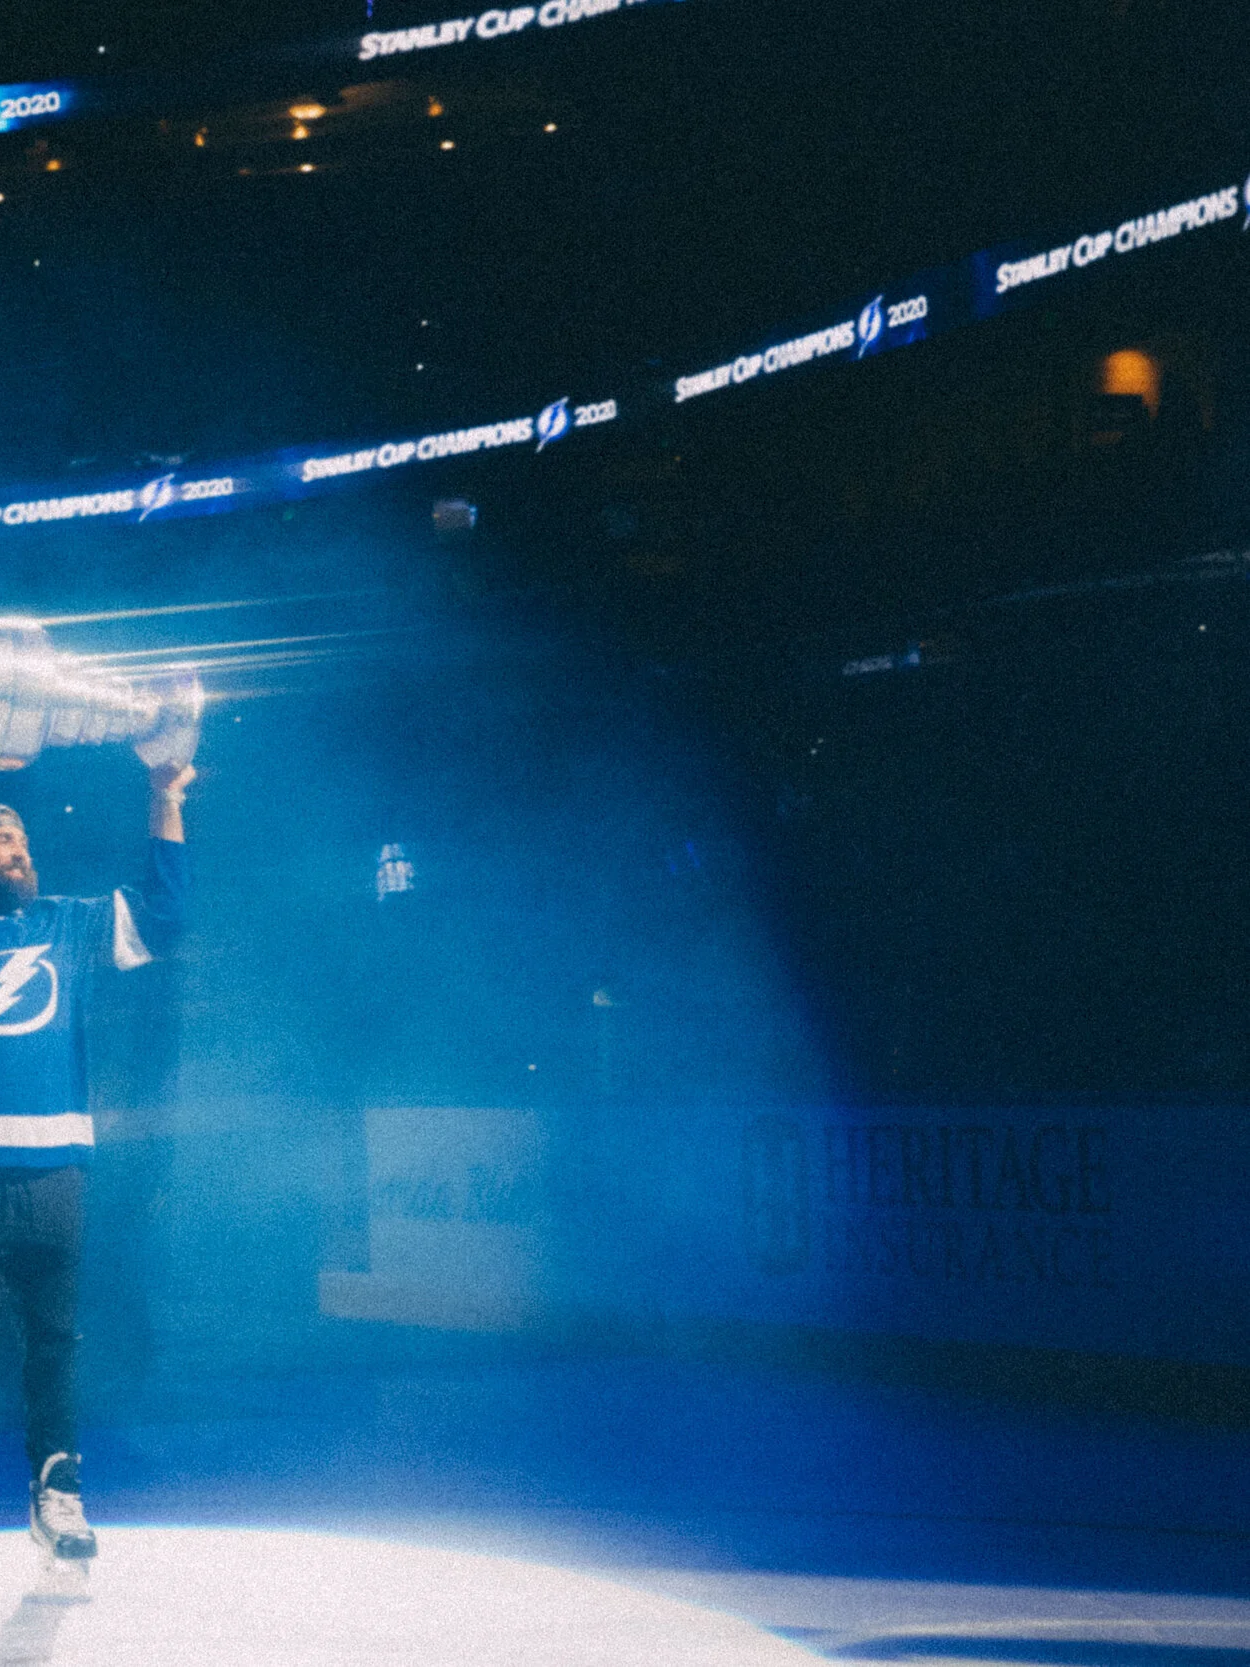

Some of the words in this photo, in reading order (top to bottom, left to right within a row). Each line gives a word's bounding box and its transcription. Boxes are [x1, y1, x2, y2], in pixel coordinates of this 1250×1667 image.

[358, 17, 474, 60] STANLEY
[475, 6, 537, 39] CUP
[0, 92, 62, 119] 2020
[995, 244, 1073, 293] STANLEY
[1072, 229, 1114, 267] CUP
[1114, 185, 1239, 253] CHAMPIONS
[732, 354, 764, 384] CUP
[763, 319, 856, 374] CHAMPIONS
[887, 295, 929, 328] 2020
[301, 449, 378, 483] STANLEY
[376, 442, 417, 468] CUP
[416, 417, 534, 460] CHAMPIONS
[2, 490, 135, 525] CHAMPIONS
[181, 476, 234, 501] 2020
[824, 1124, 1113, 1215] HERITAGE
